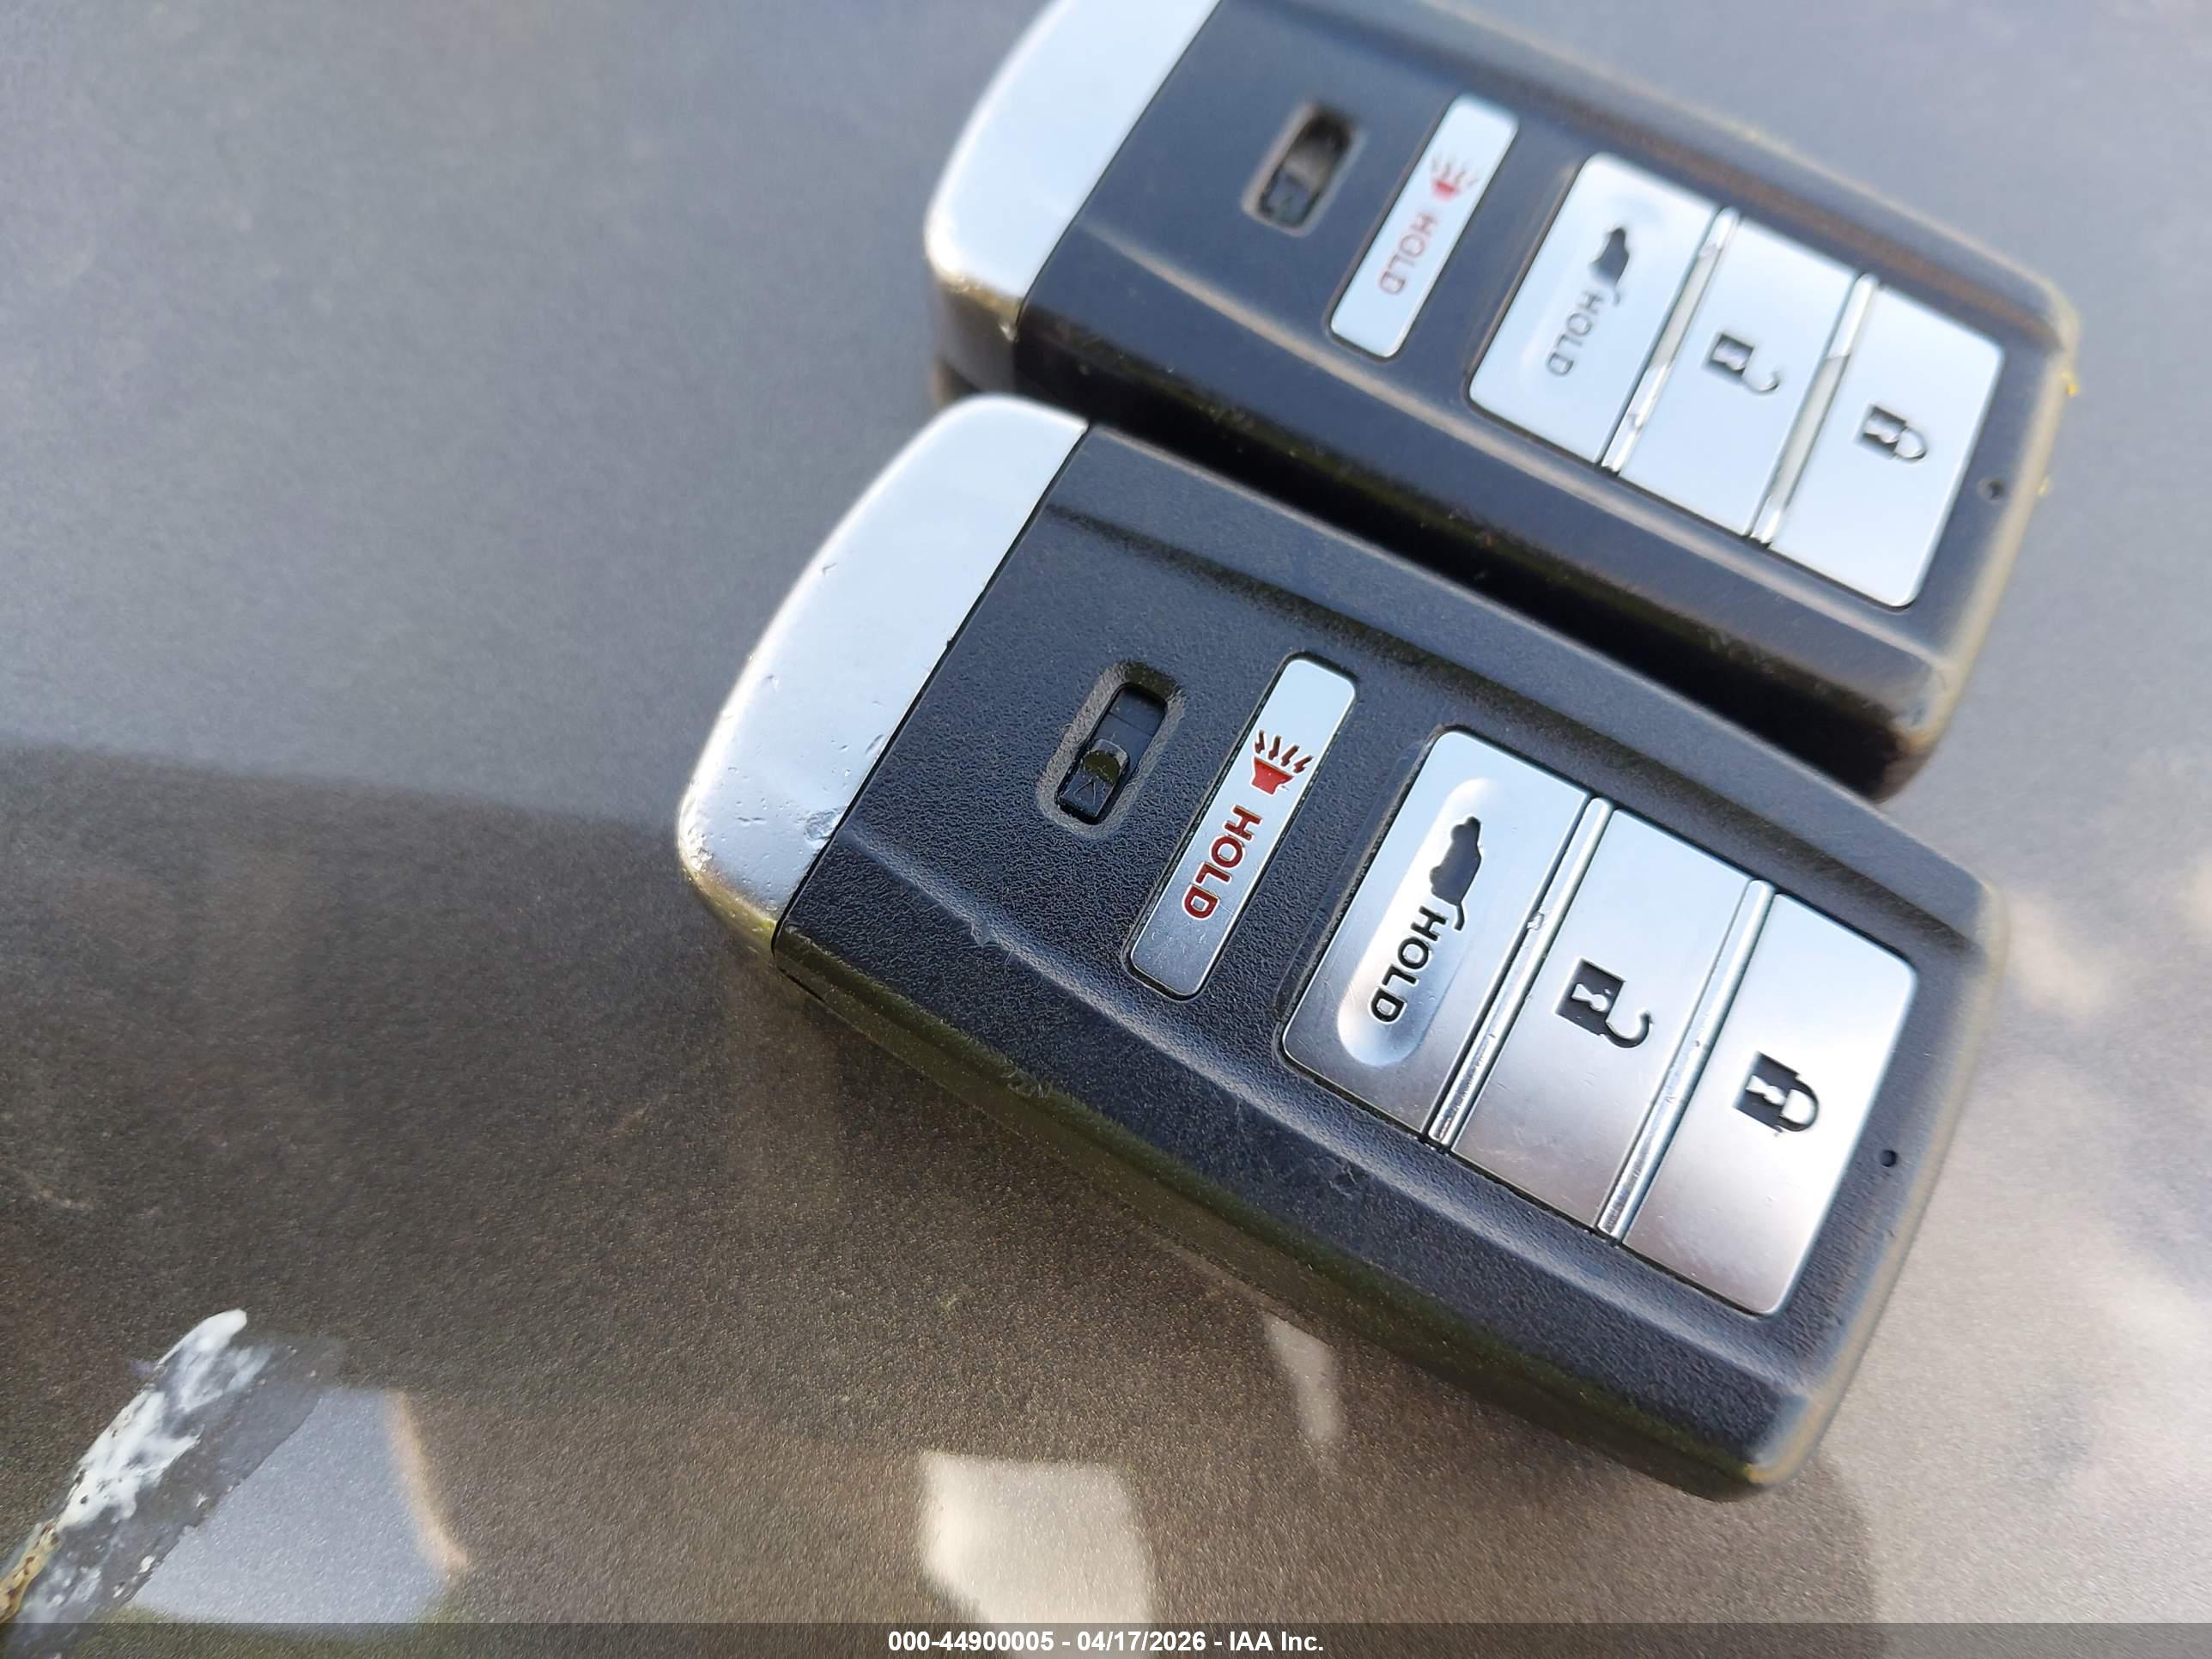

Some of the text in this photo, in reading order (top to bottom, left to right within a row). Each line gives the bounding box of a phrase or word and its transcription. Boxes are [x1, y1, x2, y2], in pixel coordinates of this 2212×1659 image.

[1379, 213, 1437, 294] HOLD
[1547, 289, 1604, 375] HOLD
[1183, 805, 1262, 919] HOLD
[1370, 906, 1449, 1023] HOLD
